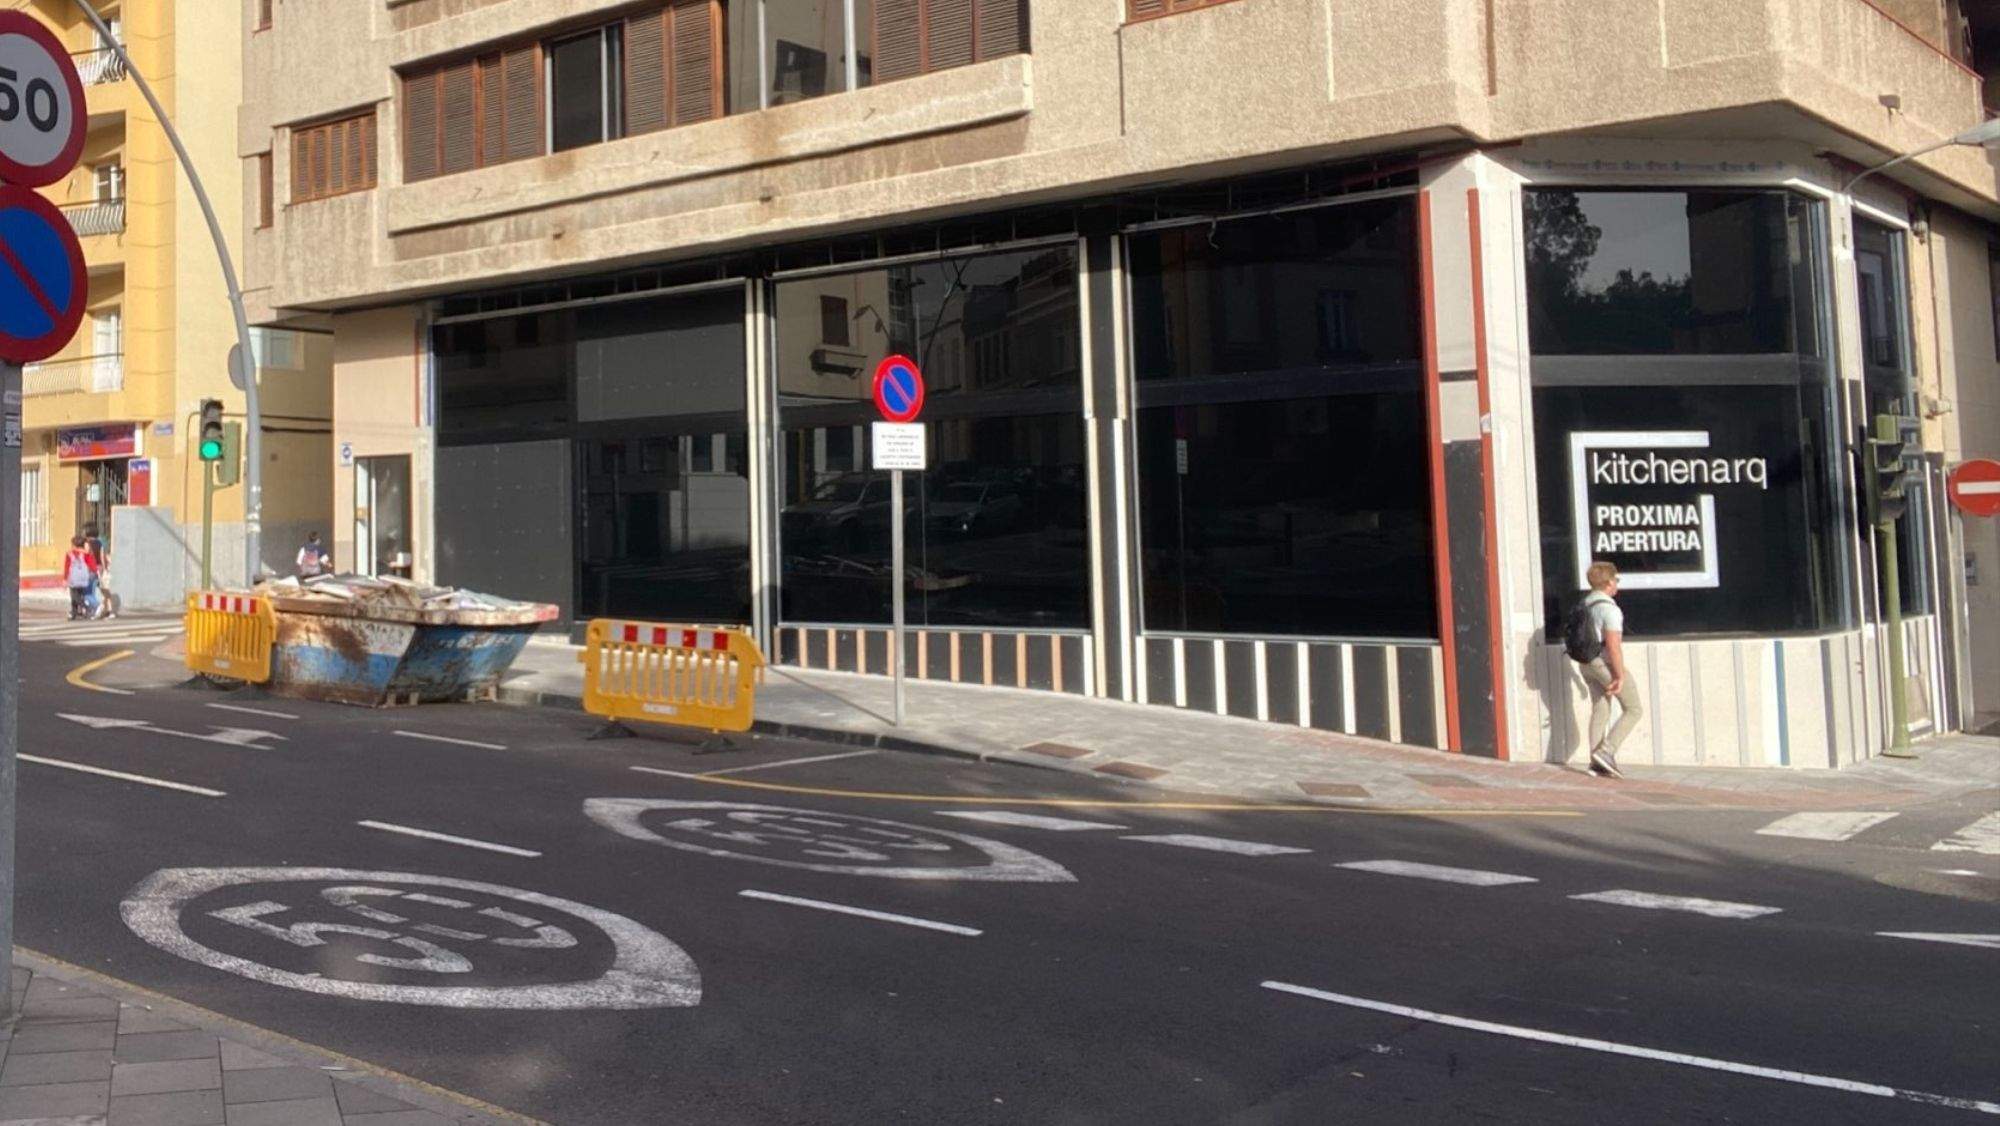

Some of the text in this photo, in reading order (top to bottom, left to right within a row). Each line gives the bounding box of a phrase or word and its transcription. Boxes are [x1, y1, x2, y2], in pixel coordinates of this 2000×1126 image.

[0, 66, 59, 133] 50
[1593, 452, 1767, 489] kitchenarq
[1596, 504, 1700, 526] PROXIMA
[1596, 530, 1701, 552] APERTURA
[207, 886, 578, 973] 50
